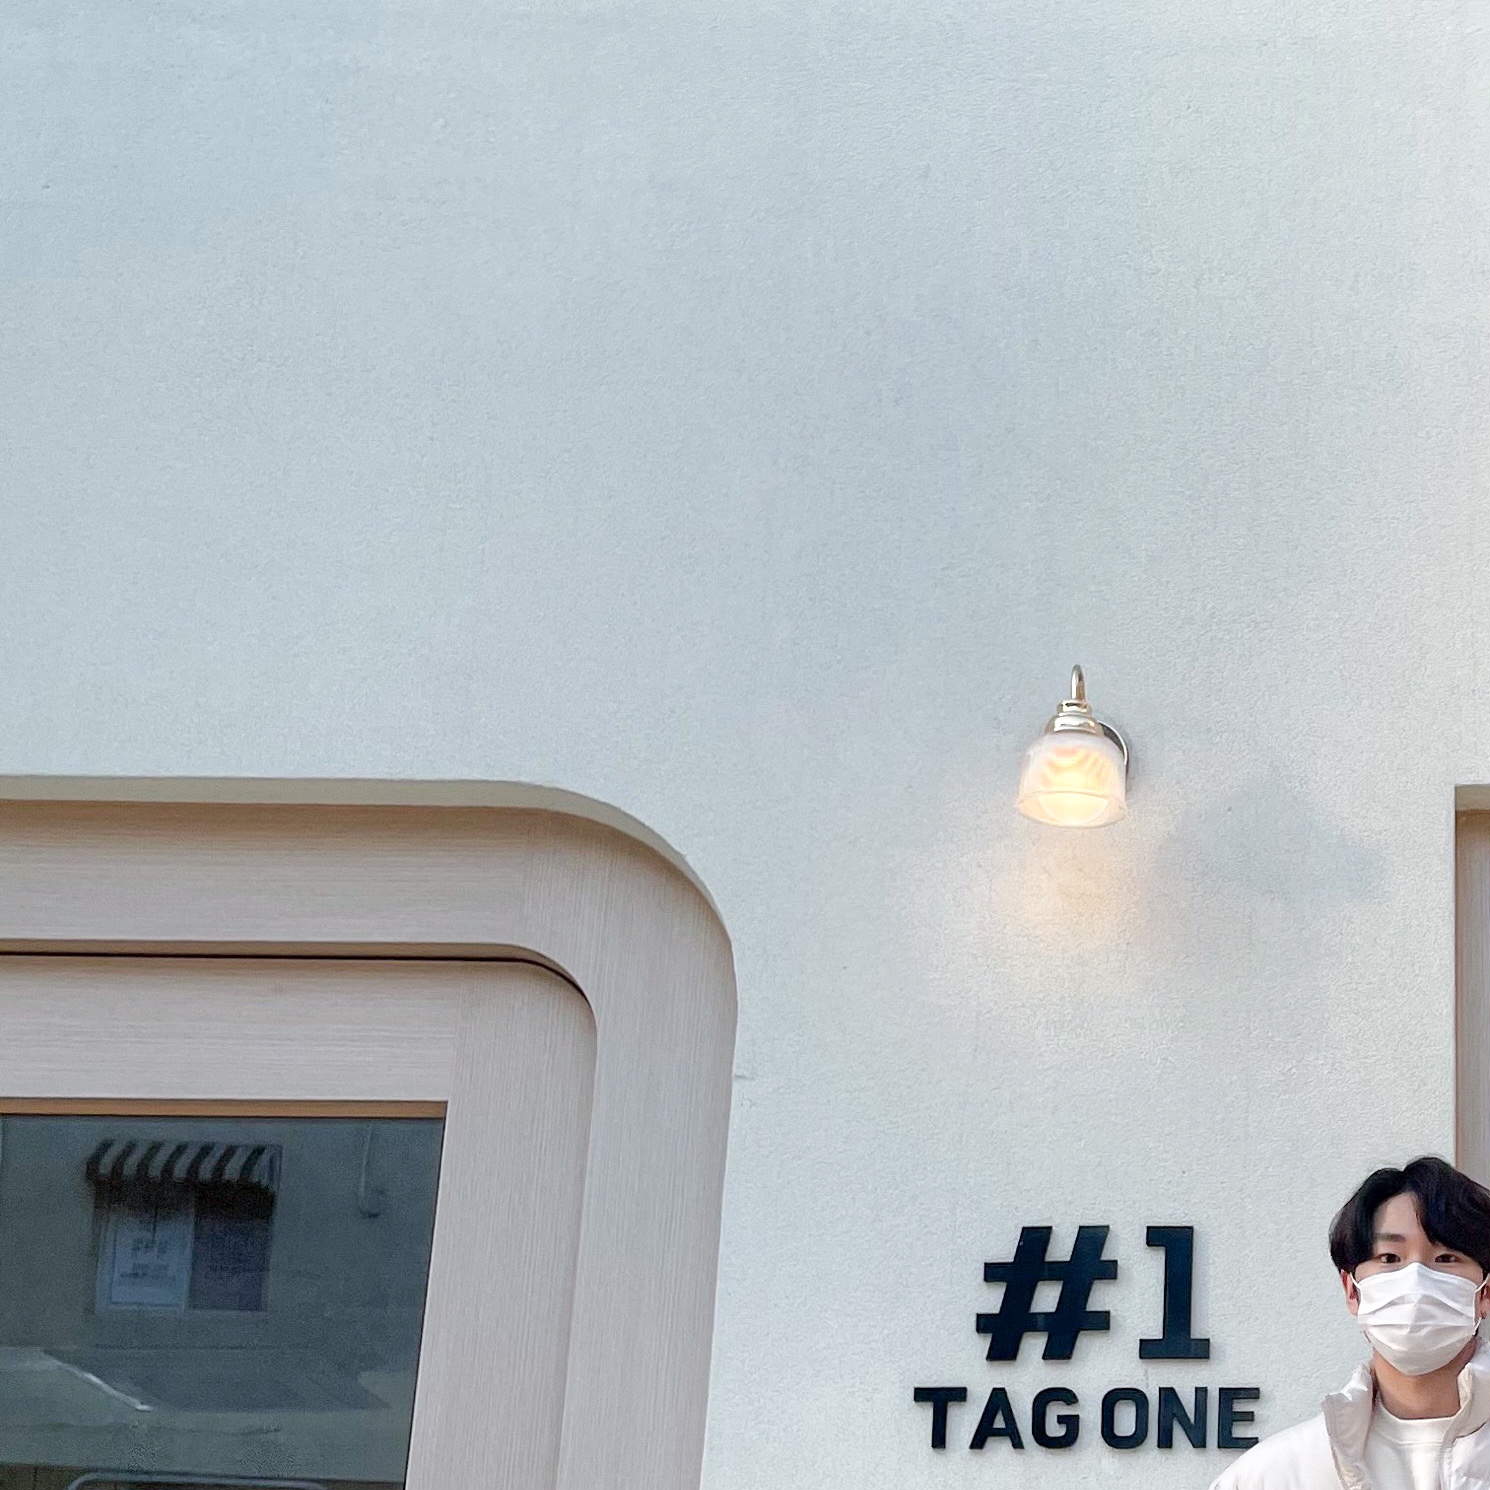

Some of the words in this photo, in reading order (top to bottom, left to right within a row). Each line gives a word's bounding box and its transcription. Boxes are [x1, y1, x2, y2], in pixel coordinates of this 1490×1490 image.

[976, 1225, 1210, 1362] #1
[914, 1387, 1080, 1450] TAG
[1101, 1387, 1260, 1450] ONE
